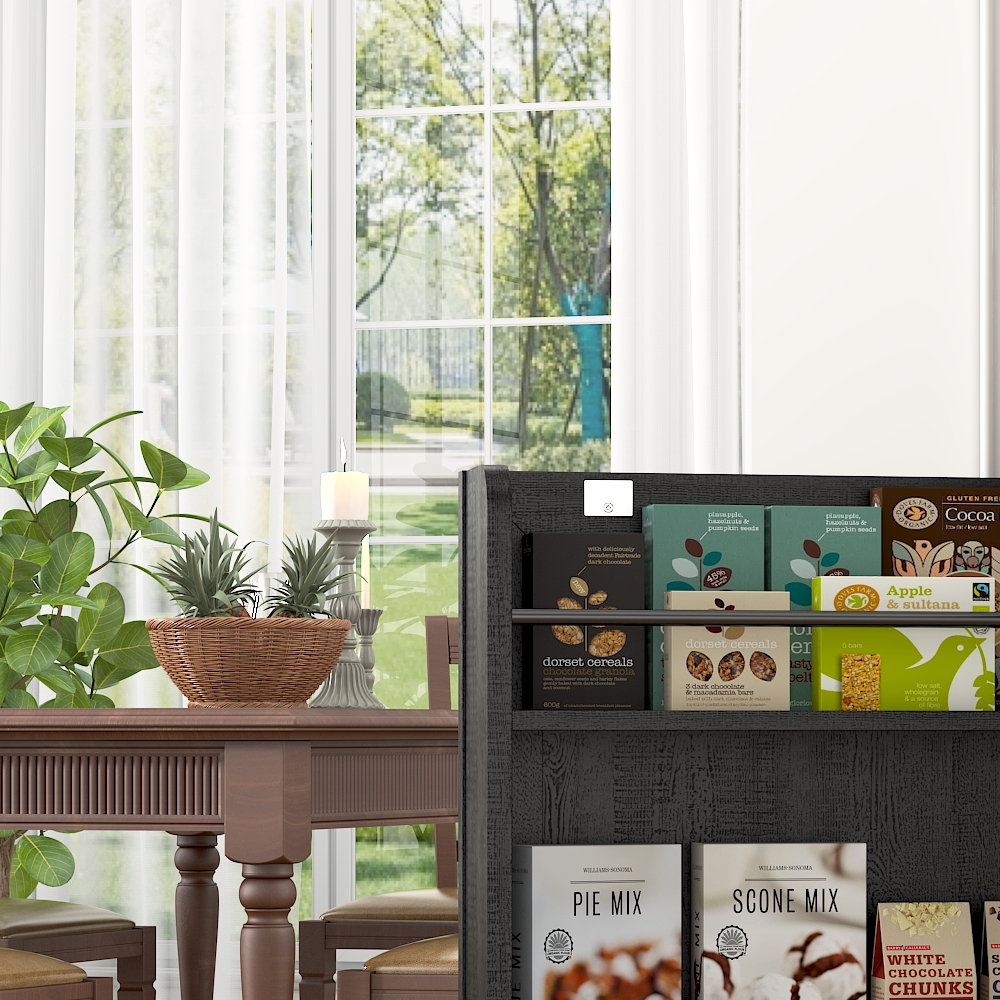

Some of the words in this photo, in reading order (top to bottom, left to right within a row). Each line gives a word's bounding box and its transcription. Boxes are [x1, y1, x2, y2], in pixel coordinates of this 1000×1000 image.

[945, 507, 996, 523] Cocoa
[571, 579, 587, 595] new
[886, 585, 932, 598] Apple
[886, 599, 899, 610] &
[902, 599, 960, 610] sultana
[685, 638, 728, 649] dorset
[730, 639, 777, 649] cereals
[542, 656, 584, 667] dorset
[587, 657, 633, 667] cereals
[543, 666, 592, 676] chocolate
[595, 667, 635, 677] granola
[543, 701, 560, 709] 600g
[573, 891, 600, 916] PIE
[611, 890, 642, 915] MIX
[733, 888, 795, 914] SCONE
[805, 888, 838, 913] MIX
[887, 954, 946, 965] WHITE
[888, 968, 973, 978] CHOCOLATE
[889, 981, 974, 996] CHUNKS
